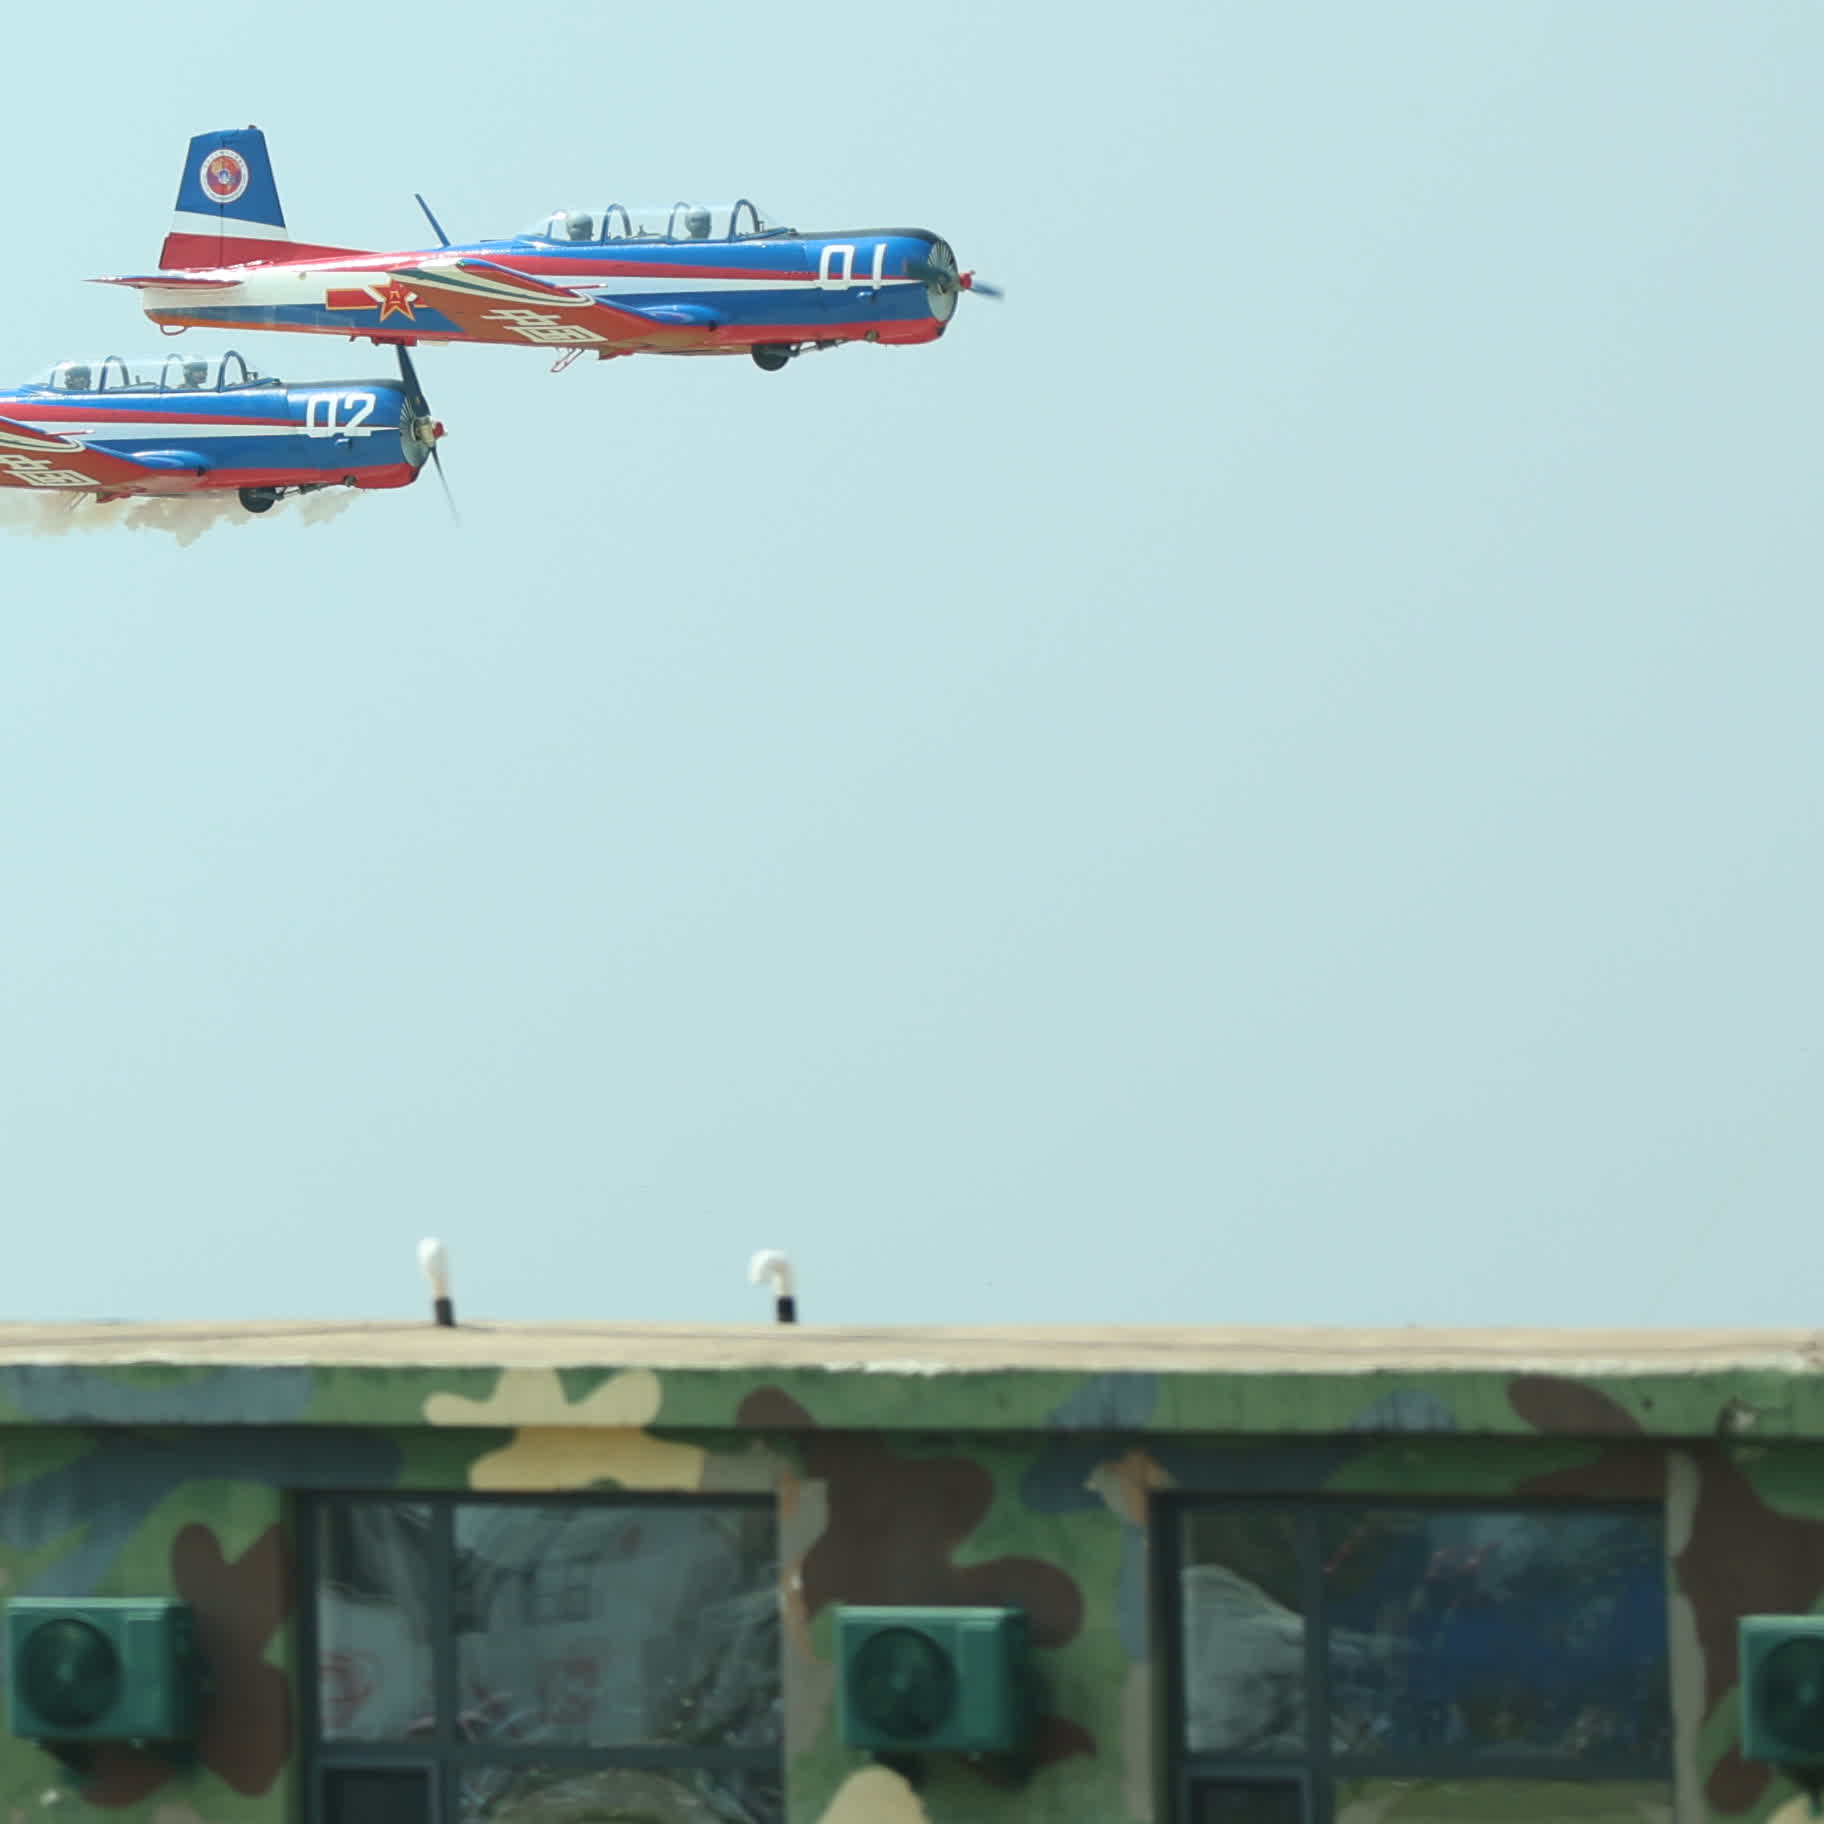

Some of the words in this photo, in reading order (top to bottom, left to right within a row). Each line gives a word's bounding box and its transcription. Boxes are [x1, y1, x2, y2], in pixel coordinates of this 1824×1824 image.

[819, 244, 887, 290] 01
[480, 309, 608, 343] 中国
[305, 393, 376, 438] 02
